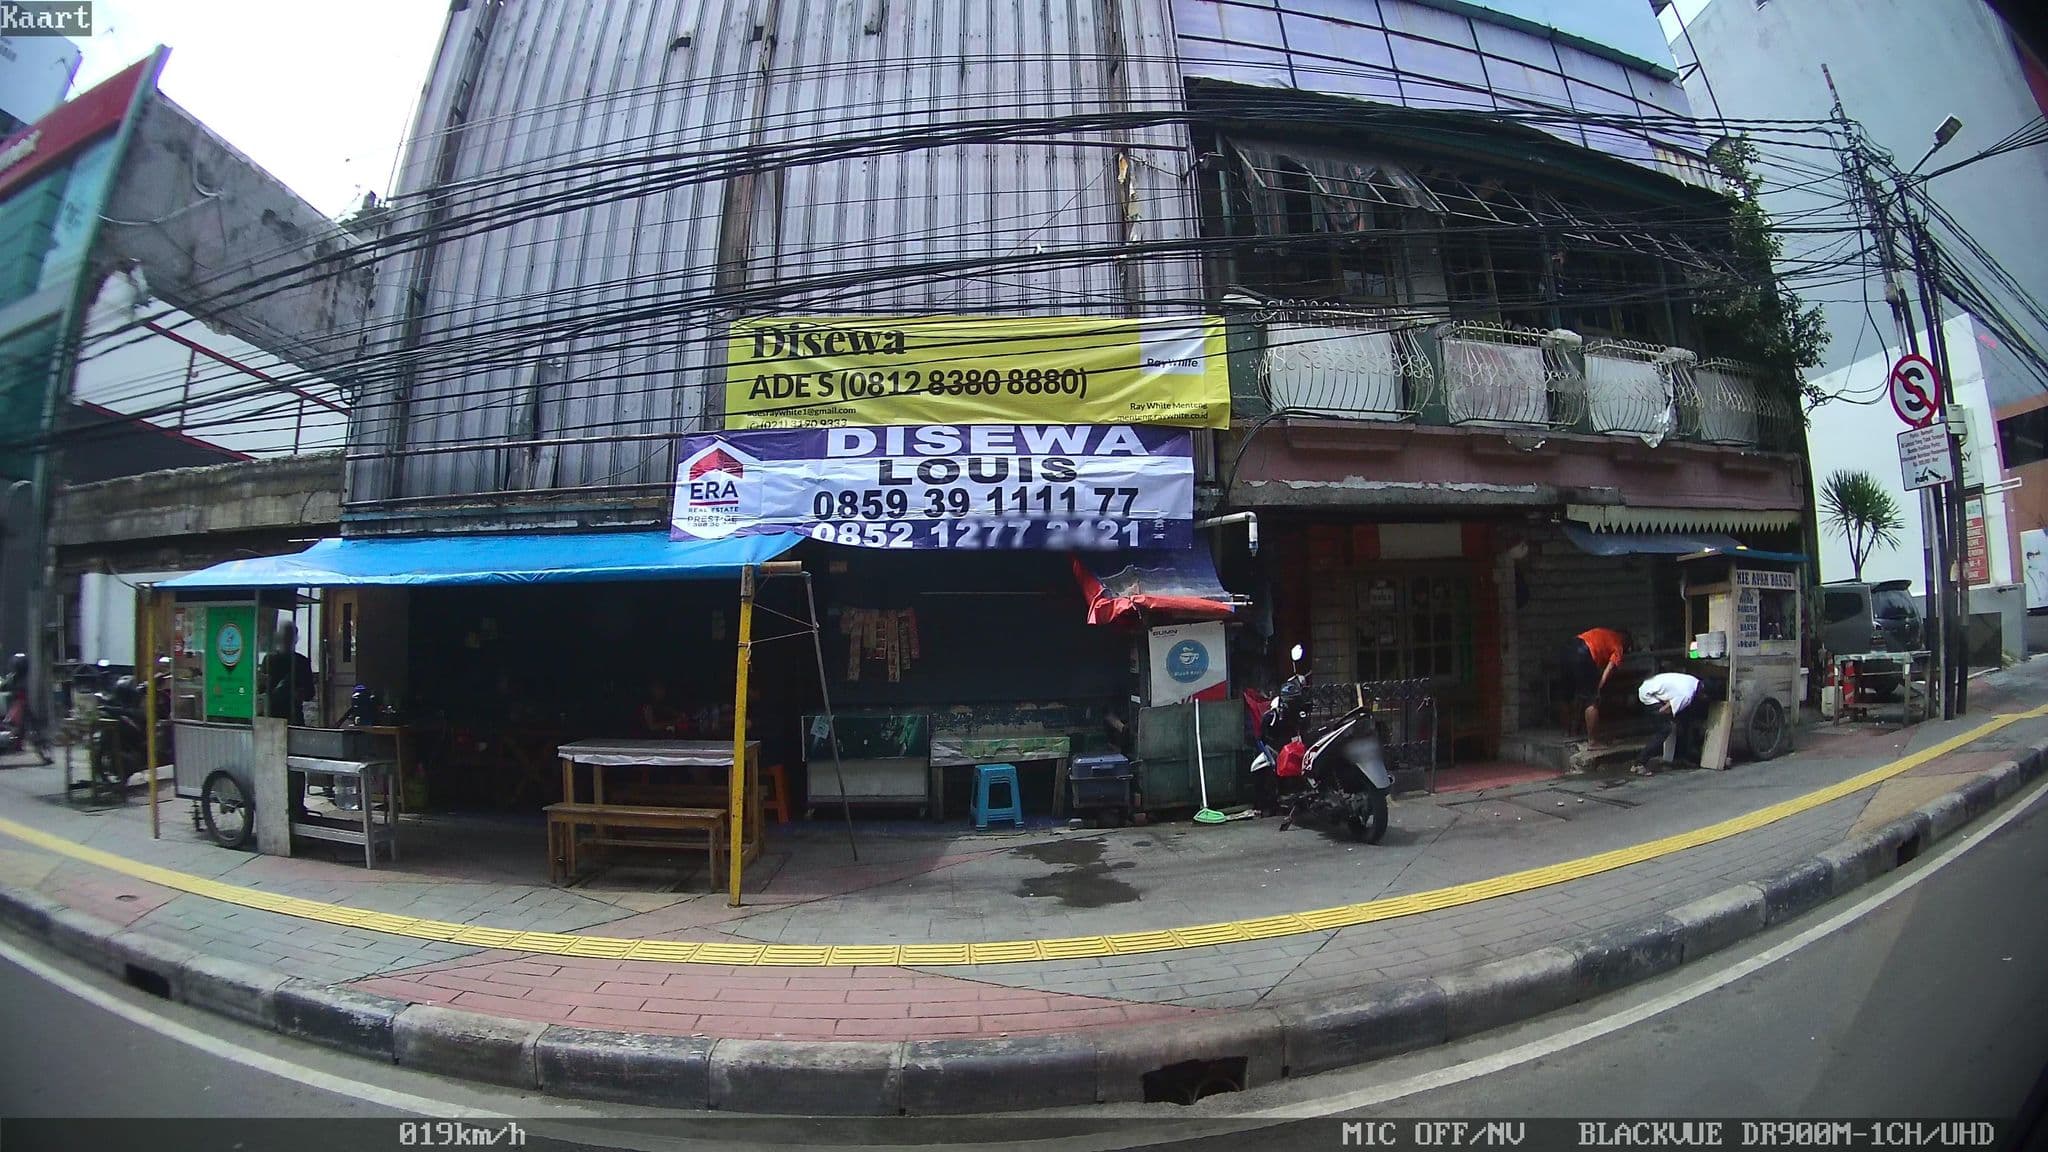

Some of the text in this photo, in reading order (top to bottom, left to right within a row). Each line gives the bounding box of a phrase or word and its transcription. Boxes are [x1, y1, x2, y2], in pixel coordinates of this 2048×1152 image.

[751, 322, 907, 358] Disewa
[749, 368, 1087, 400] ADE S (0812 8380 8880)
[1130, 402, 1145, 411] Ray
[1146, 402, 1171, 410] White
[827, 425, 1149, 457] DISEWA
[878, 457, 1077, 486] LOUIS
[689, 481, 739, 500] ERA
[814, 486, 1139, 520] 0859 39 1111 77
[812, 521, 914, 548] 0852
